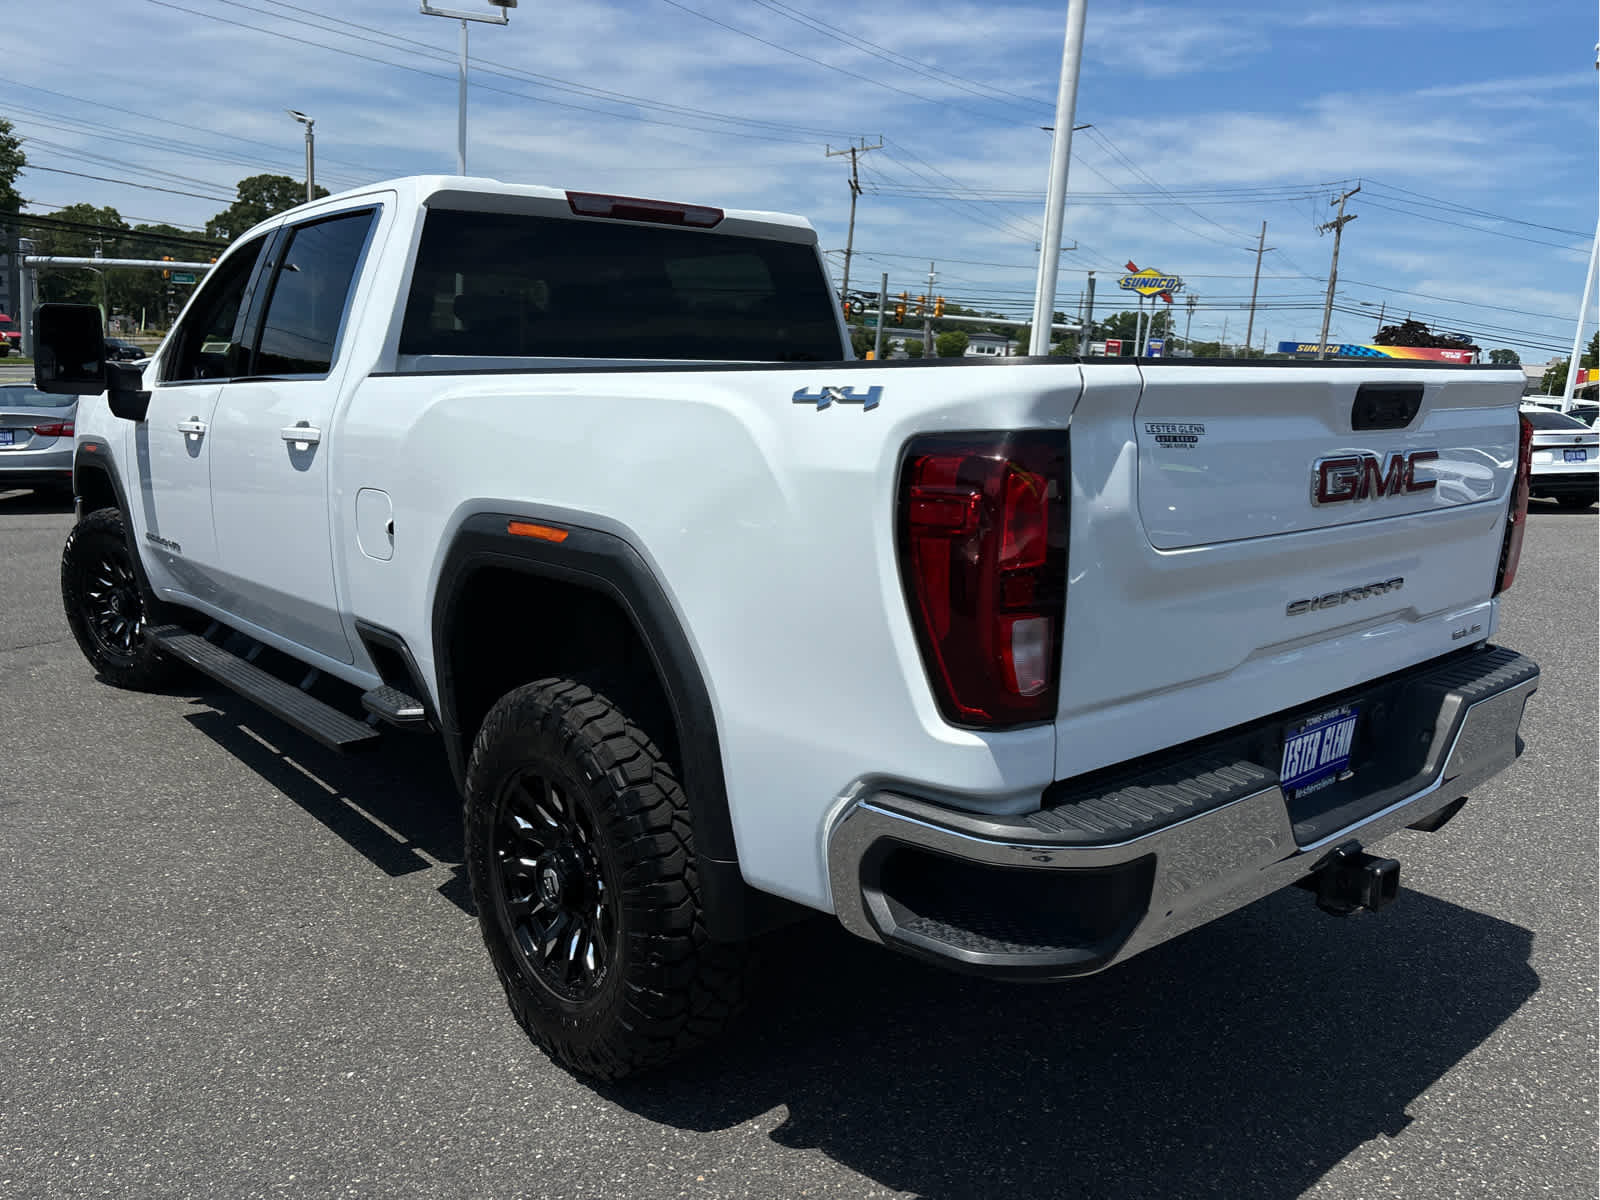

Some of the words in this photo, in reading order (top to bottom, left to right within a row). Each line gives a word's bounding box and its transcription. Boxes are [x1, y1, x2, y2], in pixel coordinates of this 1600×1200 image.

[1123, 277, 1177, 289] SUNOCO
[1296, 344, 1340, 353] SUNCO
[1144, 424, 1177, 433] LESTER
[1178, 424, 1205, 434] GLENN
[1311, 448, 1438, 507] GMC
[1286, 577, 1404, 616] SIERRA
[1280, 731, 1321, 781] LESTER
[1320, 719, 1356, 765] GLENN
